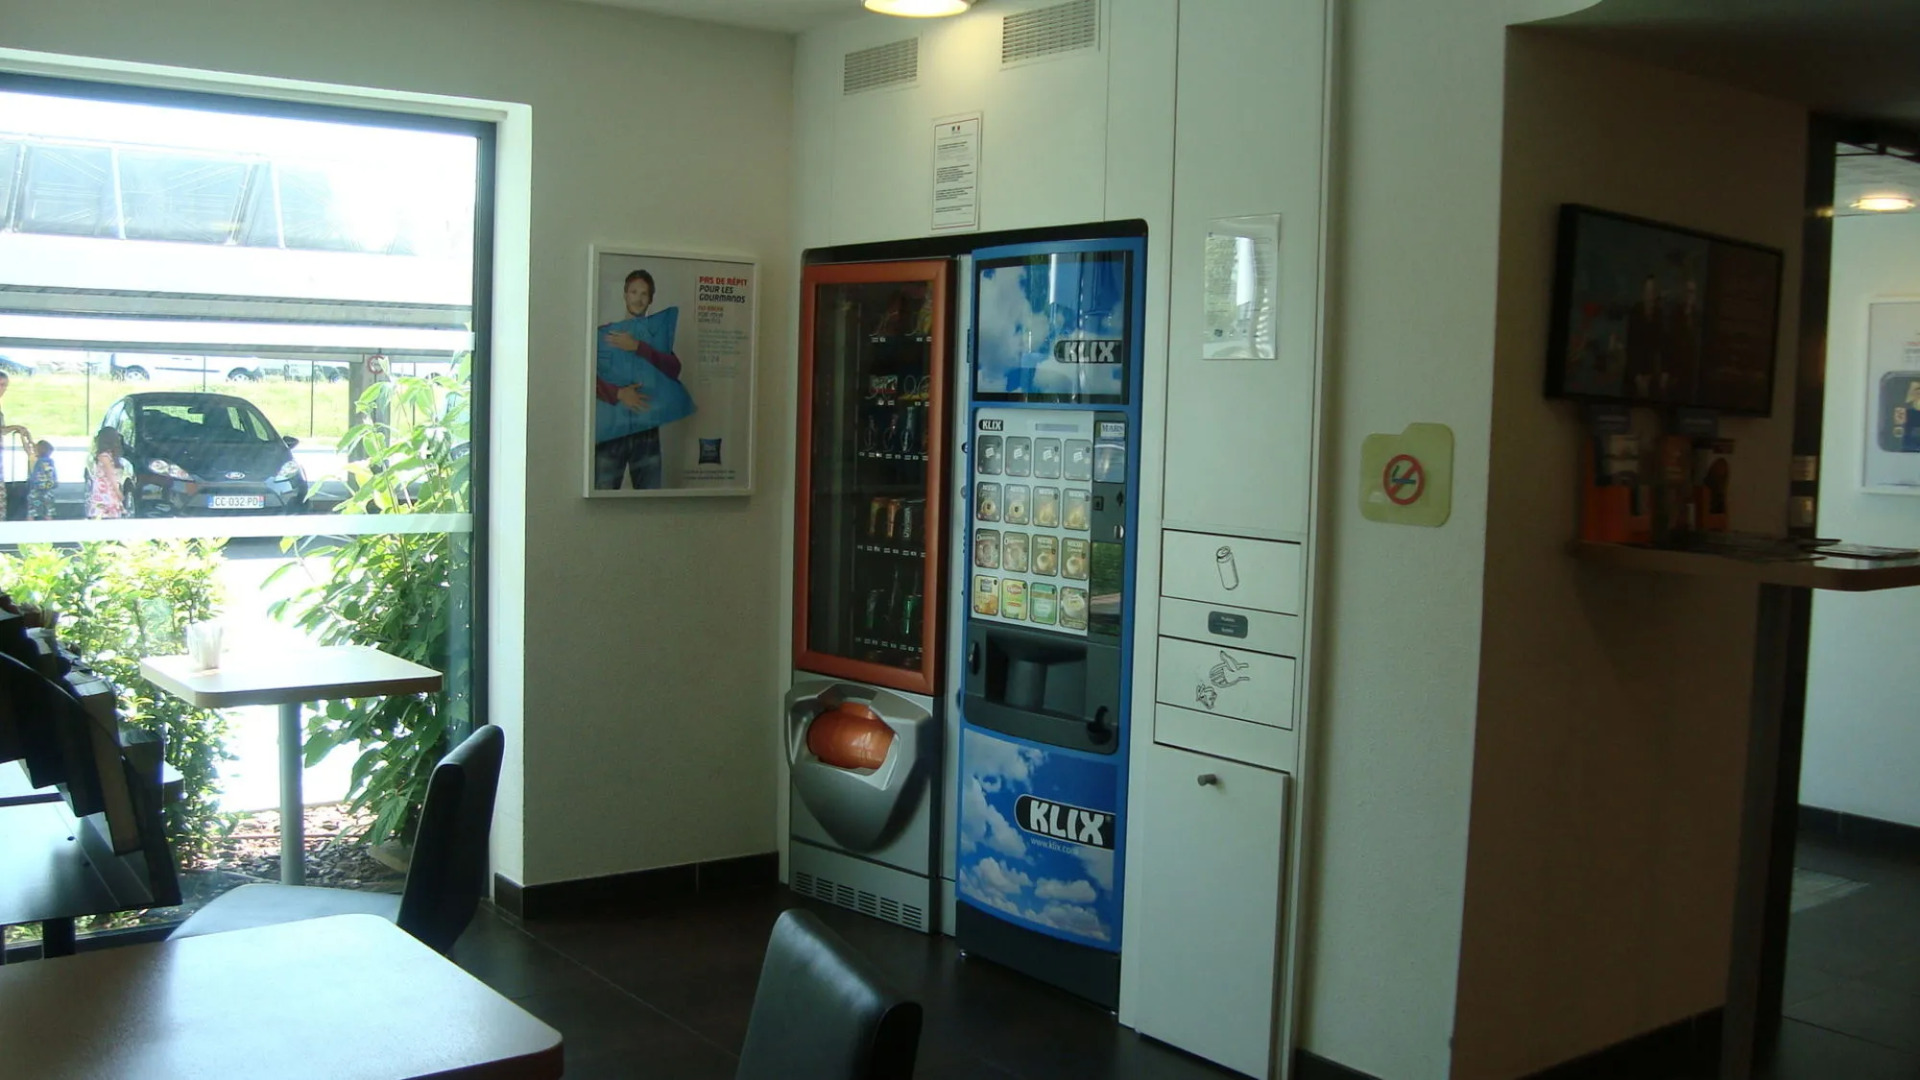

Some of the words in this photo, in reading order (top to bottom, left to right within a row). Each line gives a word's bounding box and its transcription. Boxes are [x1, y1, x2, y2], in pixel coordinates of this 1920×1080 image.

[699, 276, 714, 285] PAS
[716, 277, 726, 285] DE
[699, 285, 721, 293] POUR
[721, 286, 735, 294] LES
[699, 293, 746, 304] GOURMANDS
[1064, 341, 1114, 362] KLIX
[982, 420, 1002, 431] KLIX
[1030, 799, 1105, 846] KLIX
